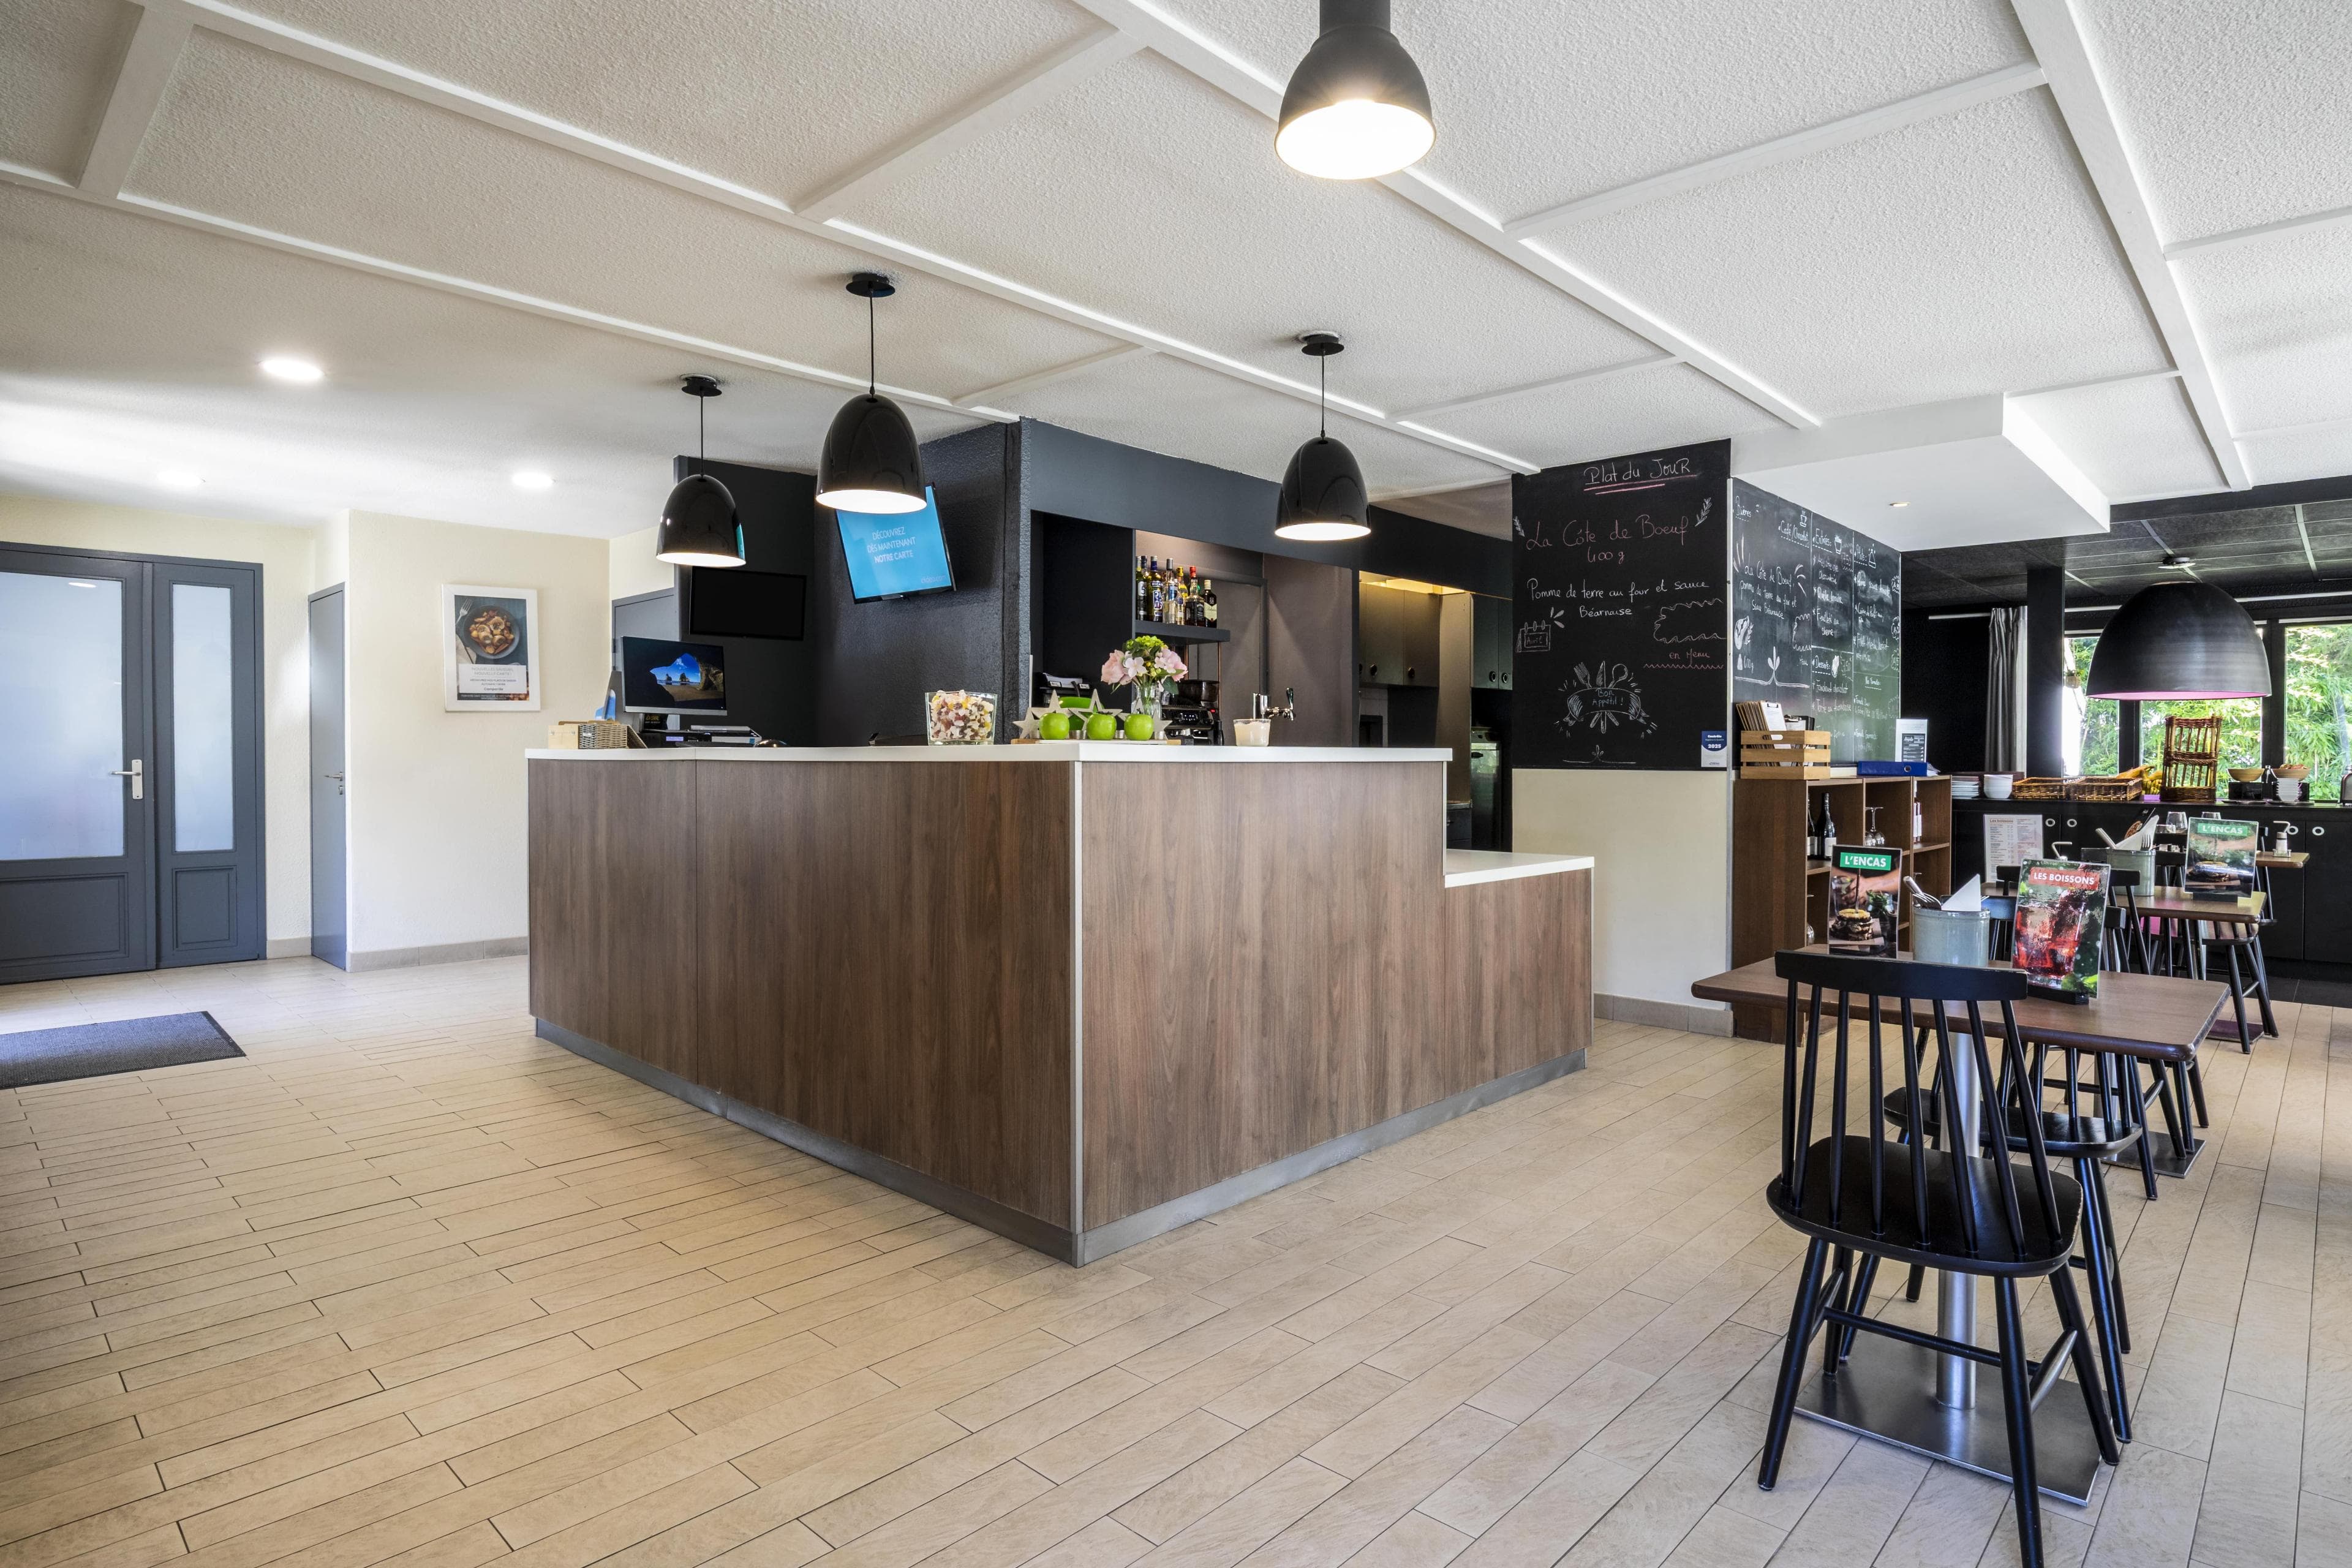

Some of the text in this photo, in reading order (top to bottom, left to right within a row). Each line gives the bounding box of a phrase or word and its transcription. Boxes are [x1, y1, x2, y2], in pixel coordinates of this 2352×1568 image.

[1584, 462, 1617, 484] Plat
[1623, 461, 1640, 480] du
[1736, 496, 1751, 518] Bières
[872, 527, 906, 540] DÉCOUVREZ
[1526, 521, 1553, 550] La
[1610, 519, 1632, 540] de
[1635, 514, 1689, 546] Boeuf
[878, 537, 916, 551] MAINTENANT
[874, 550, 914, 564] NOTRE CARTE
[1527, 578, 1561, 601] Pomme
[1566, 583, 1577, 598] de
[1581, 579, 1604, 599] terre
[1628, 582, 1649, 603] four
[1656, 579, 1668, 593] et
[1579, 605, 1633, 618] Béarnaise
[1686, 648, 1711, 665] Menu
[2202, 825, 2244, 834] L'ENCAS
[1844, 855, 1887, 867] L'ENCAS
[2034, 872, 2095, 886] LES BOISSONS
